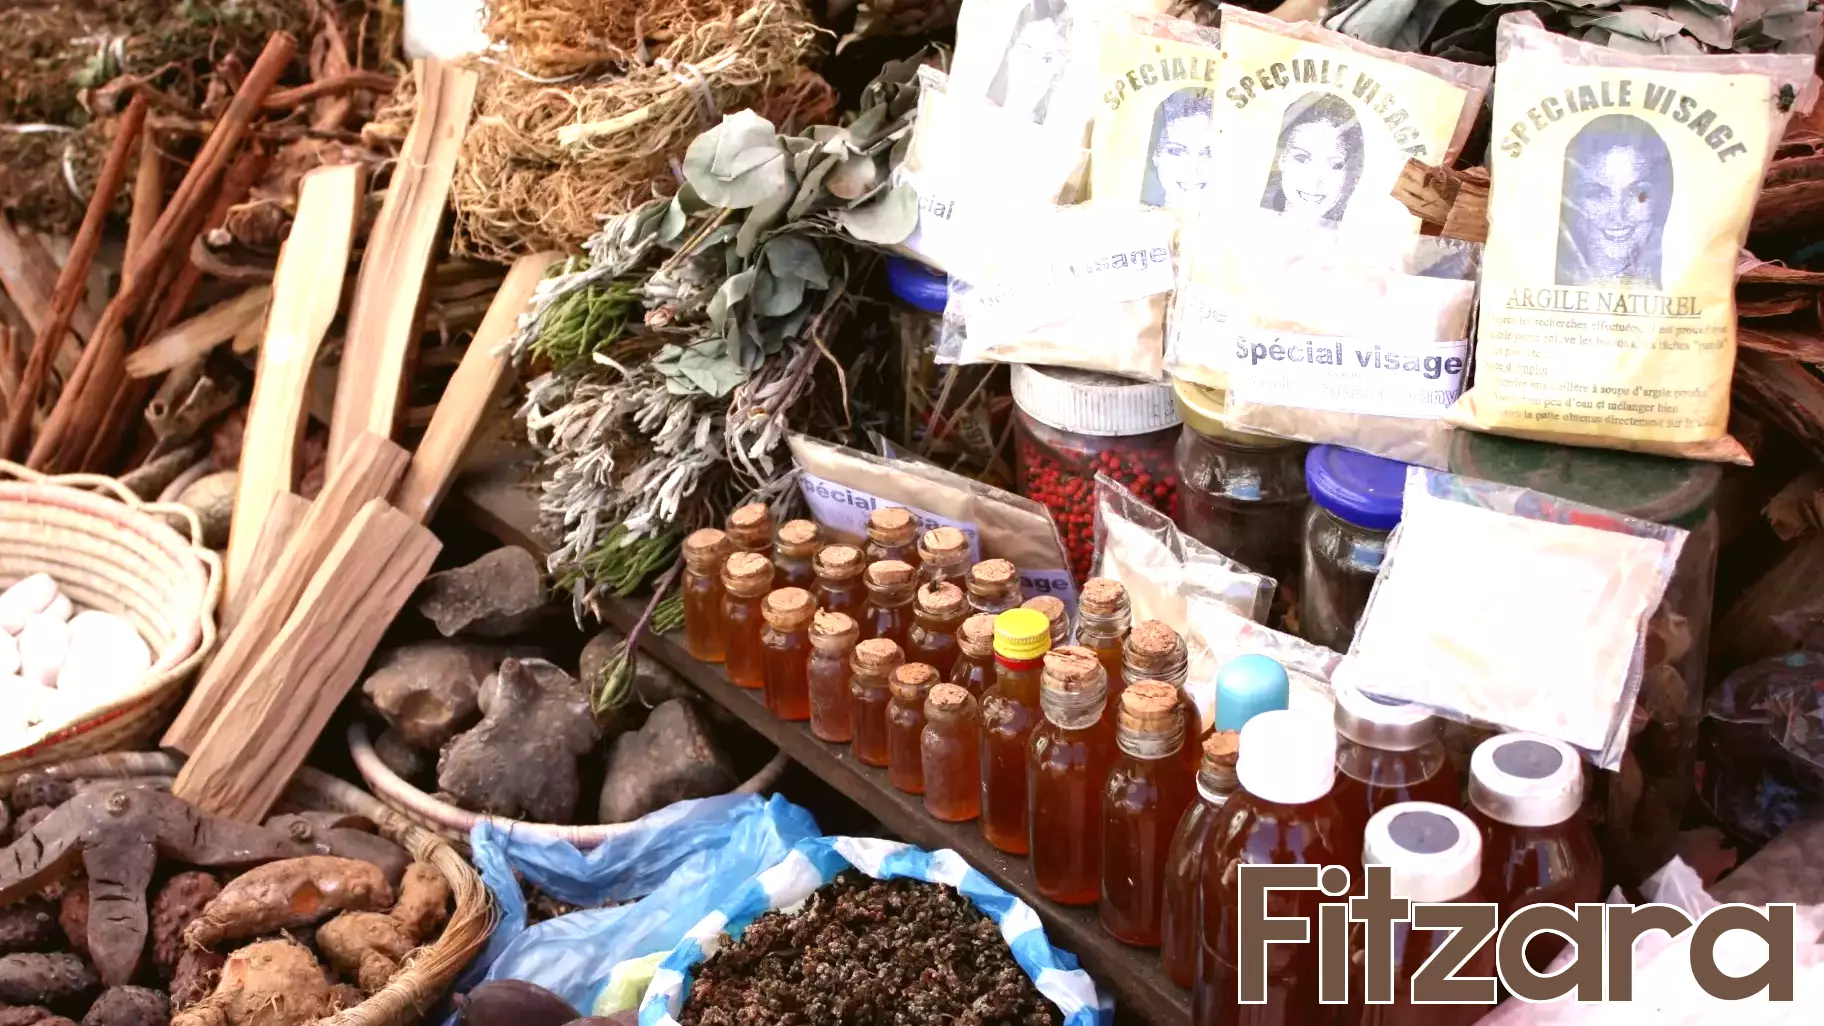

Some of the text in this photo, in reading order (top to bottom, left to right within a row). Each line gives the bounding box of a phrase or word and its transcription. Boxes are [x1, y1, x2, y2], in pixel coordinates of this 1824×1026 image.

[1103, 56, 1216, 110] SPECIALE
[1500, 80, 1748, 173] SPECIALE VISAGE
[1506, 288, 1701, 315] ARGILE NATUREL
[1235, 336, 1463, 380] Spécial visage
[1524, 410, 1533, 419] la
[1020, 575, 1069, 594] age
